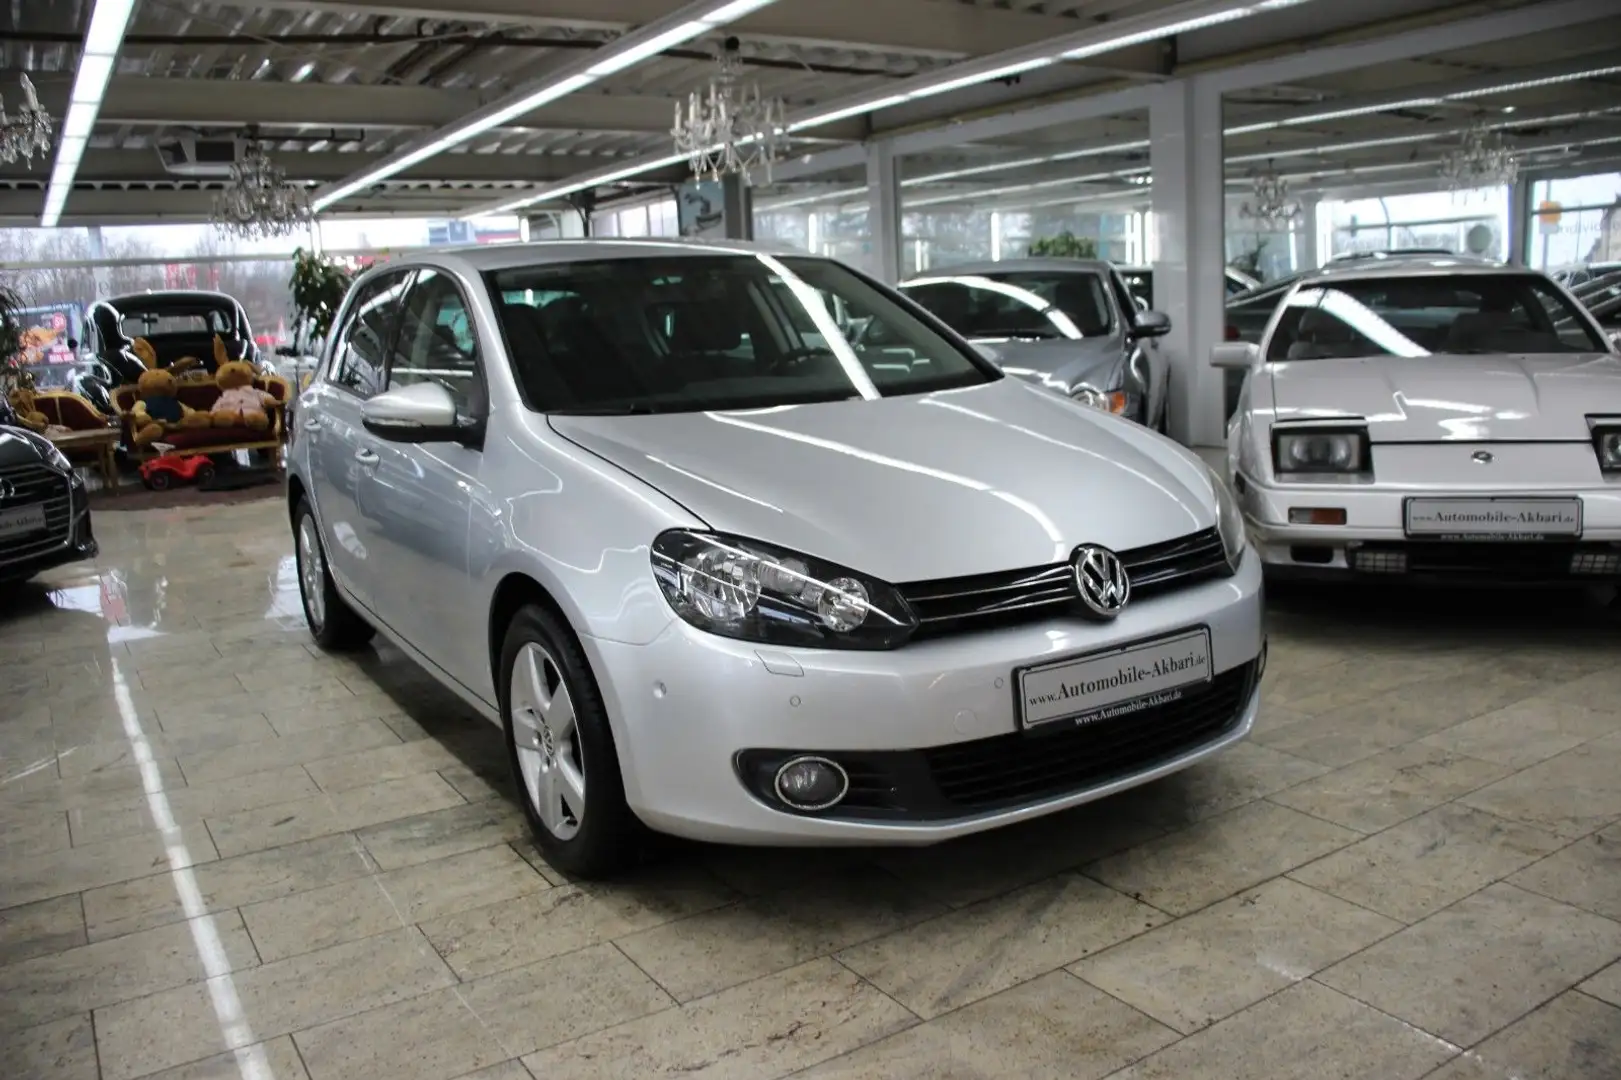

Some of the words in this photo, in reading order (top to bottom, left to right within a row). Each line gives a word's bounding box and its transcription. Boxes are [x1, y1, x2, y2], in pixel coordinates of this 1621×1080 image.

[1412, 511, 1575, 524] www.Automobile-Akbari.de
[1028, 652, 1206, 706] www.Automobile-Akbari.de
[1074, 690, 1182, 726] www.Automobile-Akbari.de
